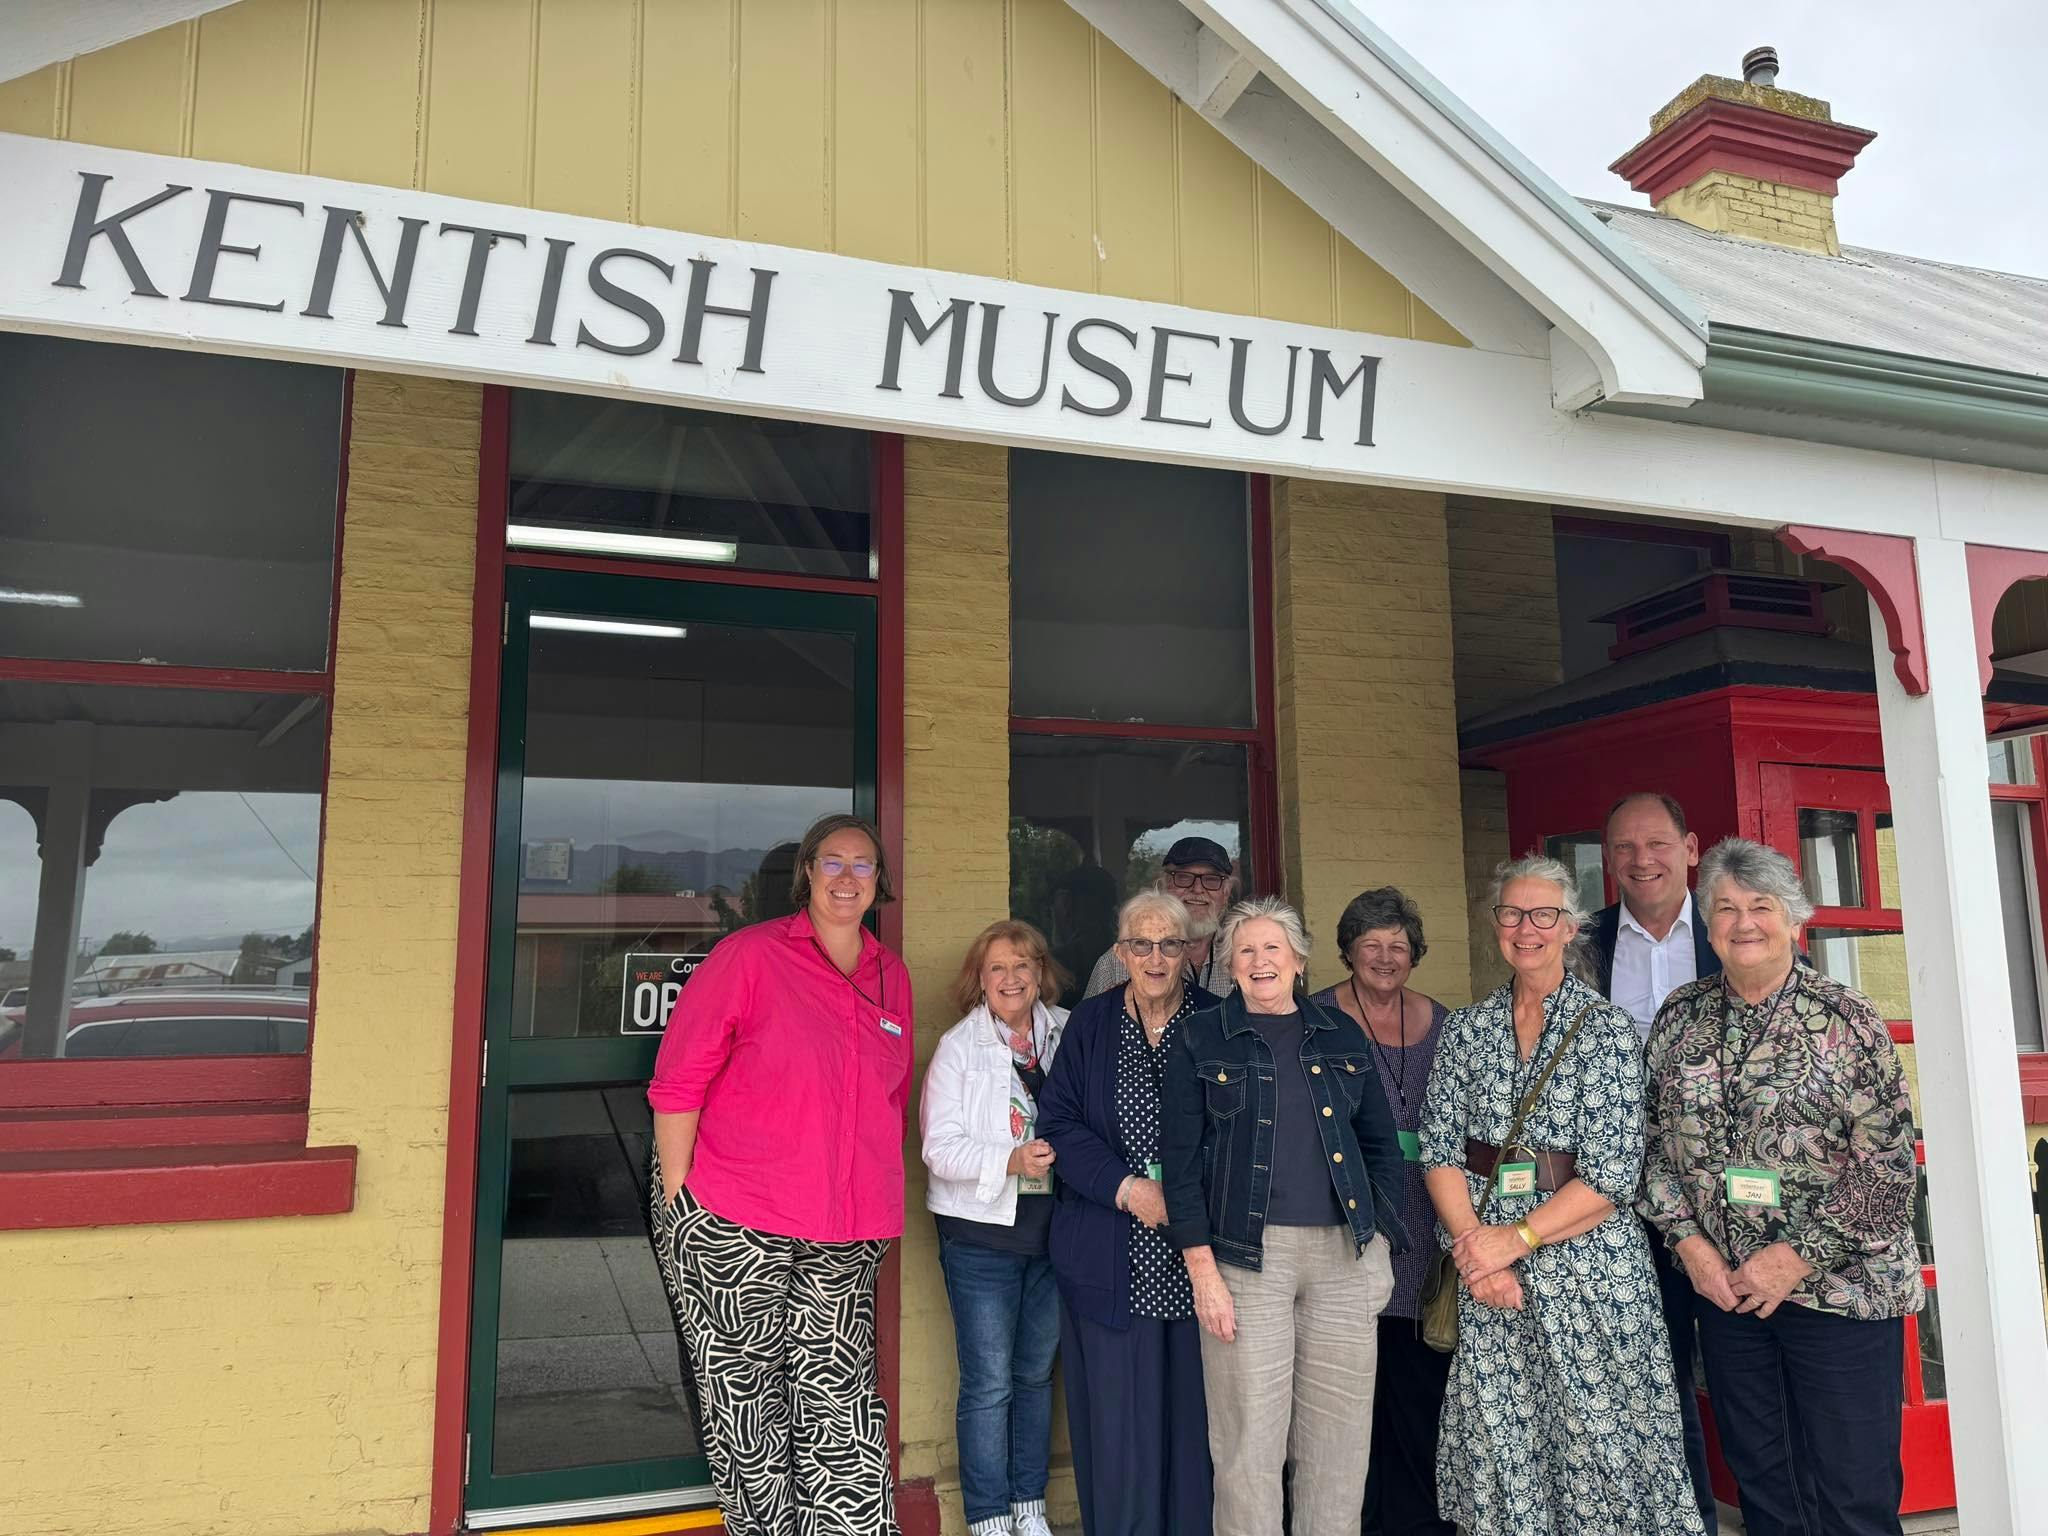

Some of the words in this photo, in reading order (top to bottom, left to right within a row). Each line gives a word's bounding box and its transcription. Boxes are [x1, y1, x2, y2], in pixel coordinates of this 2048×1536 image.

[52, 172, 779, 374] KENTISH
[876, 288, 1382, 447] MUSEUM
[635, 971, 649, 981] WE
[649, 972, 664, 981] ARE
[1509, 1182, 1526, 1190] SALLY
